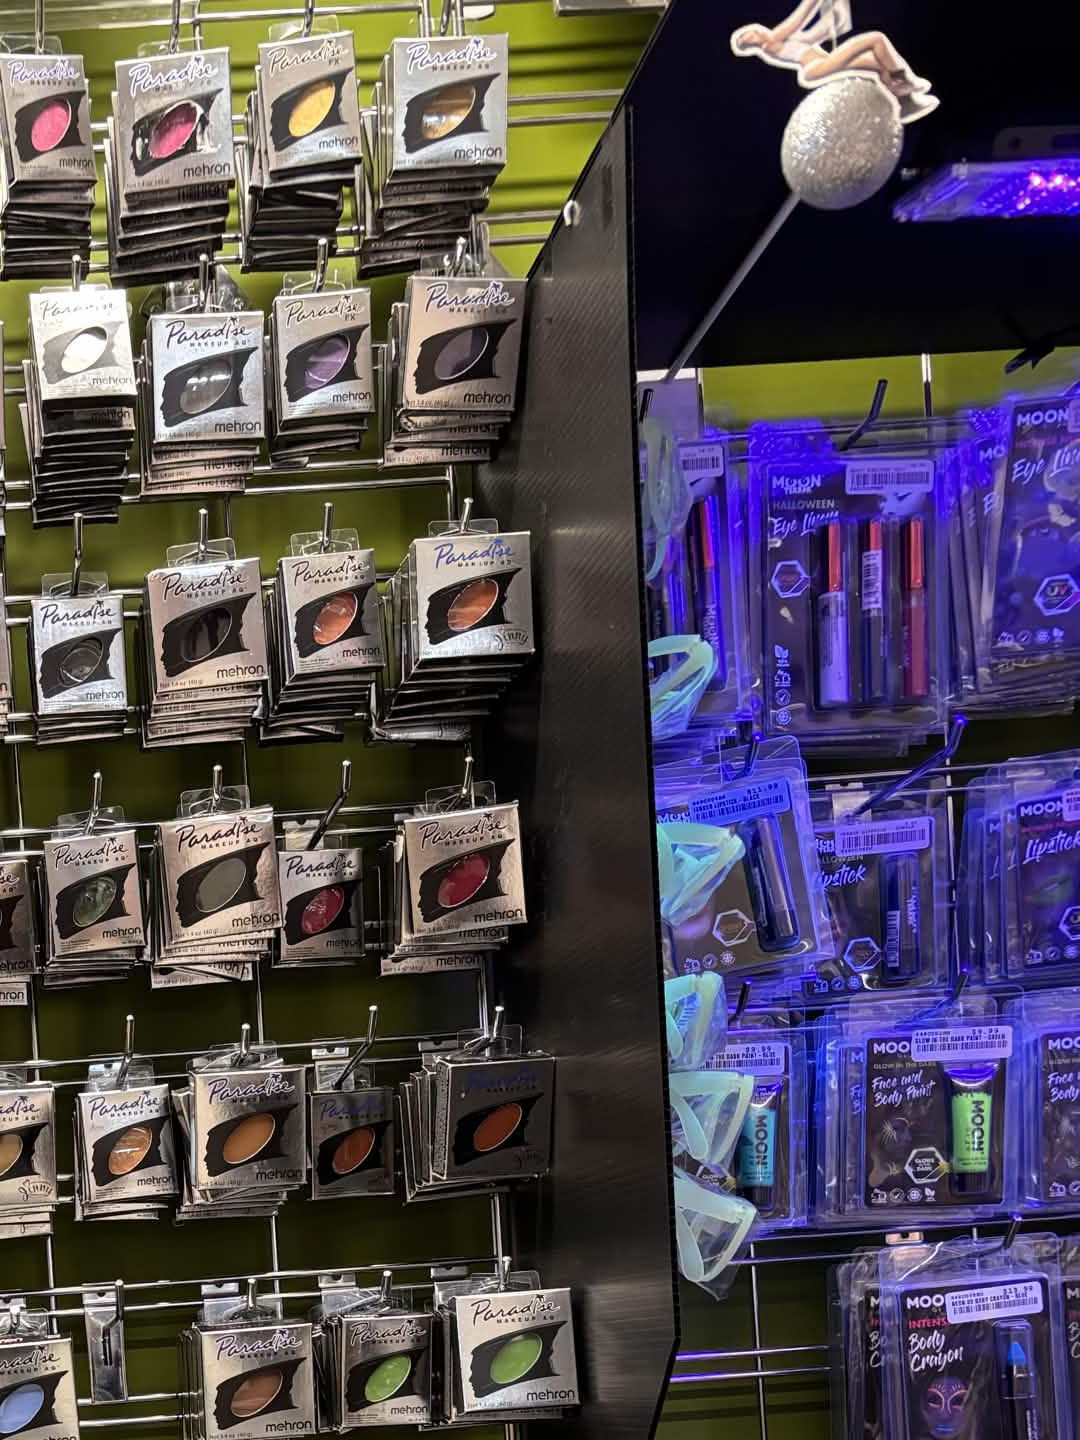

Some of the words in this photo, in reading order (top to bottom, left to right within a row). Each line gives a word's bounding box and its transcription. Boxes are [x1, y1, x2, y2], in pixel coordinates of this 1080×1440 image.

[406, 38, 497, 73] Paradise
[9, 58, 80, 87] Paradise
[184, 161, 231, 177] mehron
[424, 281, 515, 312] Paradise
[214, 419, 262, 433] mehron
[292, 557, 369, 584] Paradise
[41, 601, 117, 626] Paradise
[216, 663, 264, 679] mehron
[422, 814, 507, 847] Paradise
[54, 837, 129, 868] Paradise
[232, 912, 279, 928] mehron
[208, 1073, 296, 1107] Paradise
[971, 1099, 986, 1153] MOON
[754, 1114, 768, 1166] MOON
[255, 1167, 303, 1181] mehron
[908, 1330, 946, 1355] Body
[909, 1346, 964, 1373] Crayon
[526, 1388, 576, 1401] mehron
